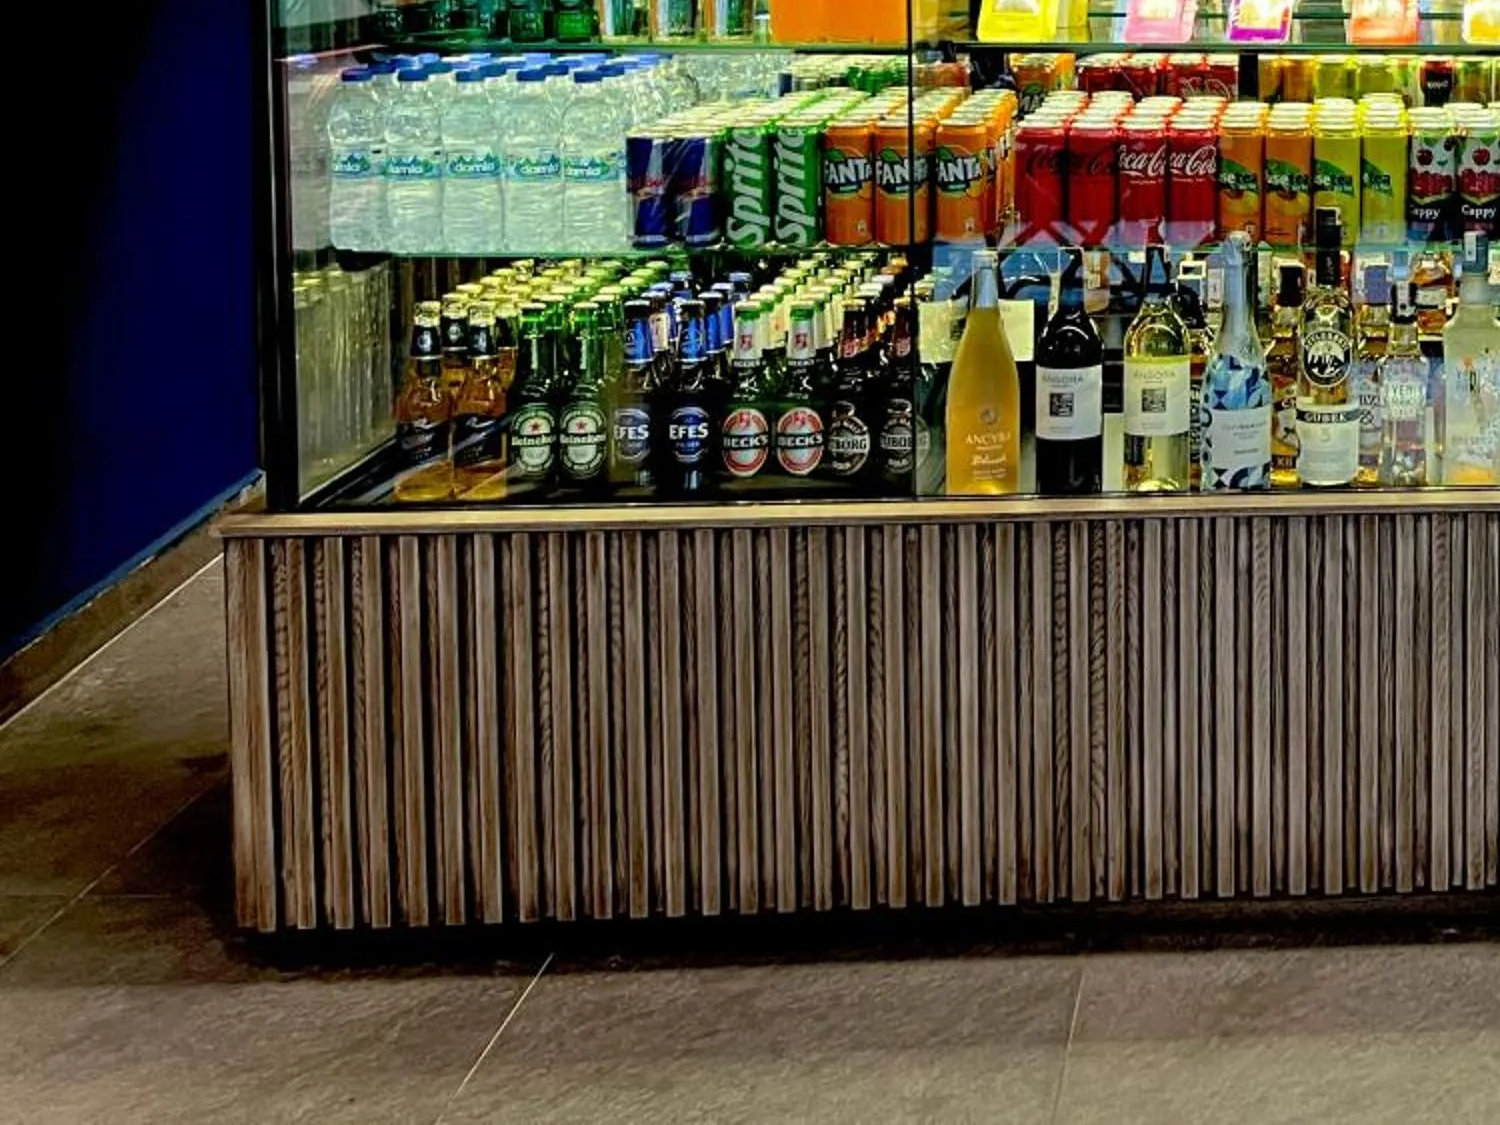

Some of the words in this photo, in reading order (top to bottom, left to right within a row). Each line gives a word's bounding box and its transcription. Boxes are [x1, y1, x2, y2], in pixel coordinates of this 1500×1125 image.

[725, 127, 770, 248] Sprite
[773, 127, 815, 248] Sprite
[1410, 205, 1440, 220] appy
[1461, 204, 1497, 219] Cappy
[613, 425, 649, 440] EFES
[669, 423, 709, 440] EFES
